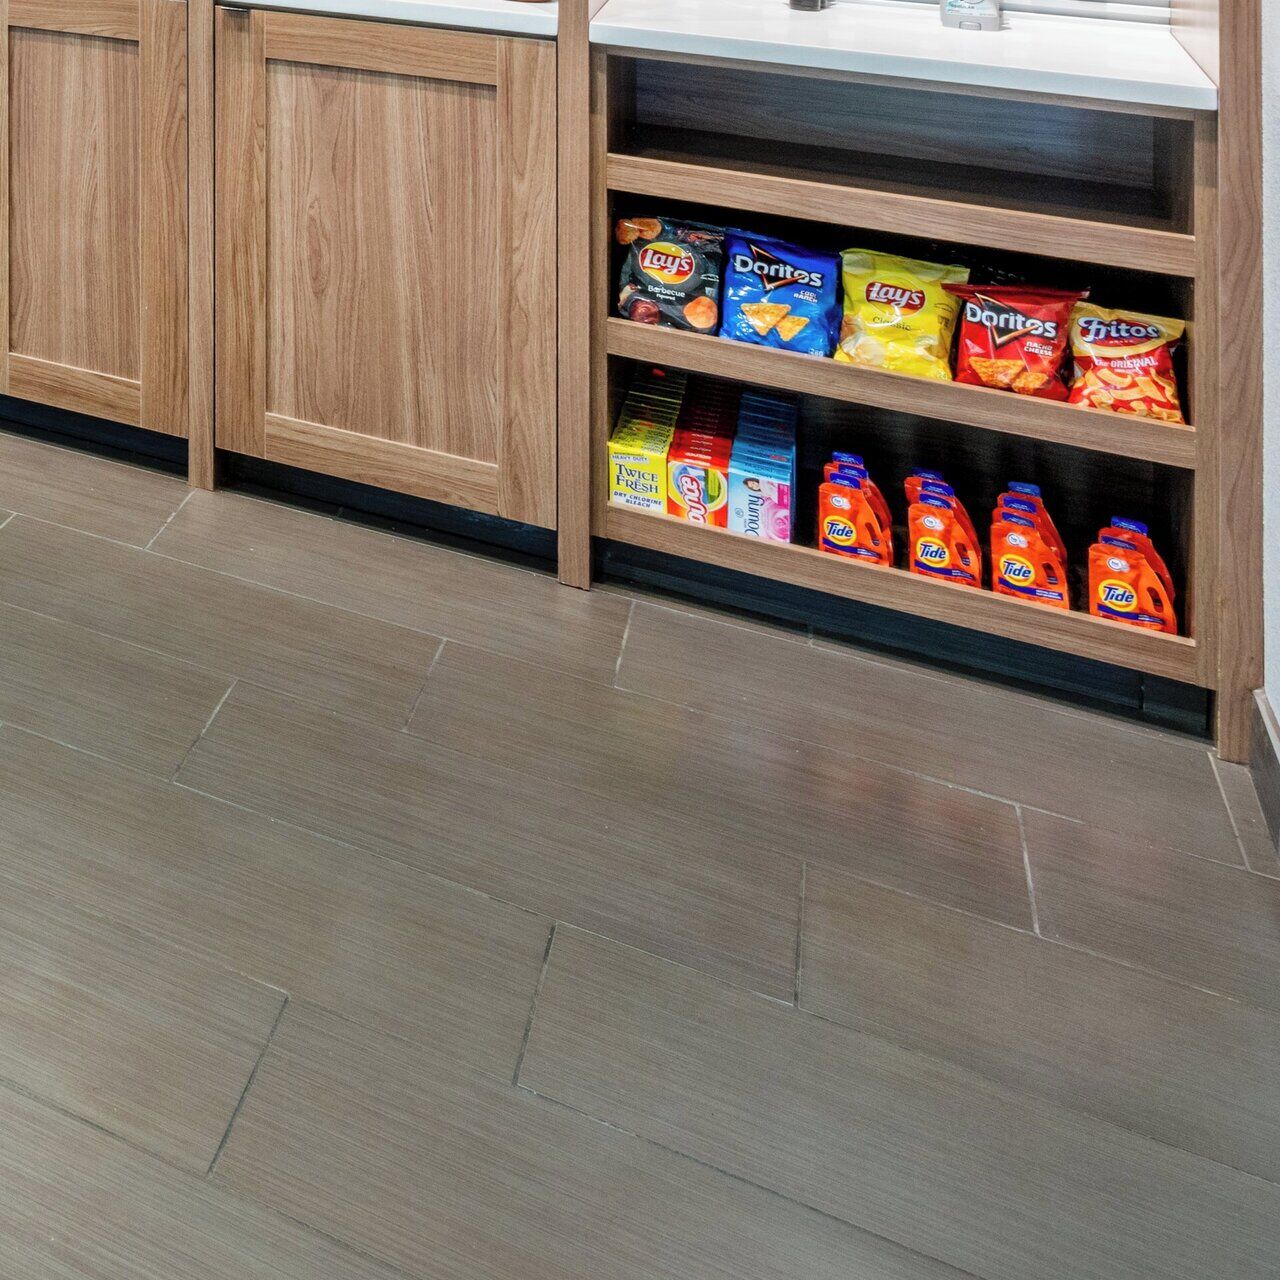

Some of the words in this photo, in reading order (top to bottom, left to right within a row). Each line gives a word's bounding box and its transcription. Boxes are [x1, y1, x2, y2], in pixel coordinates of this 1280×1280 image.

[735, 254, 823, 287] Doritos
[647, 284, 686, 298] Barbecue
[965, 302, 1057, 339] Doritos
[1077, 317, 1160, 343] Fritos
[1023, 346, 1054, 357] CHEESE
[1026, 341, 1053, 351] NACHO
[1110, 356, 1159, 369] ORIGINAL
[615, 463, 658, 482] TWICE
[616, 474, 659, 493] FRESH
[613, 490, 627, 498] DRY
[629, 493, 662, 506] CHLORINE
[625, 499, 651, 508] BLEACH
[680, 474, 707, 525] ounce
[826, 521, 854, 539] Tide
[919, 542, 947, 560] Tide
[1003, 561, 1032, 579] Tide
[1103, 586, 1135, 604] Tide
